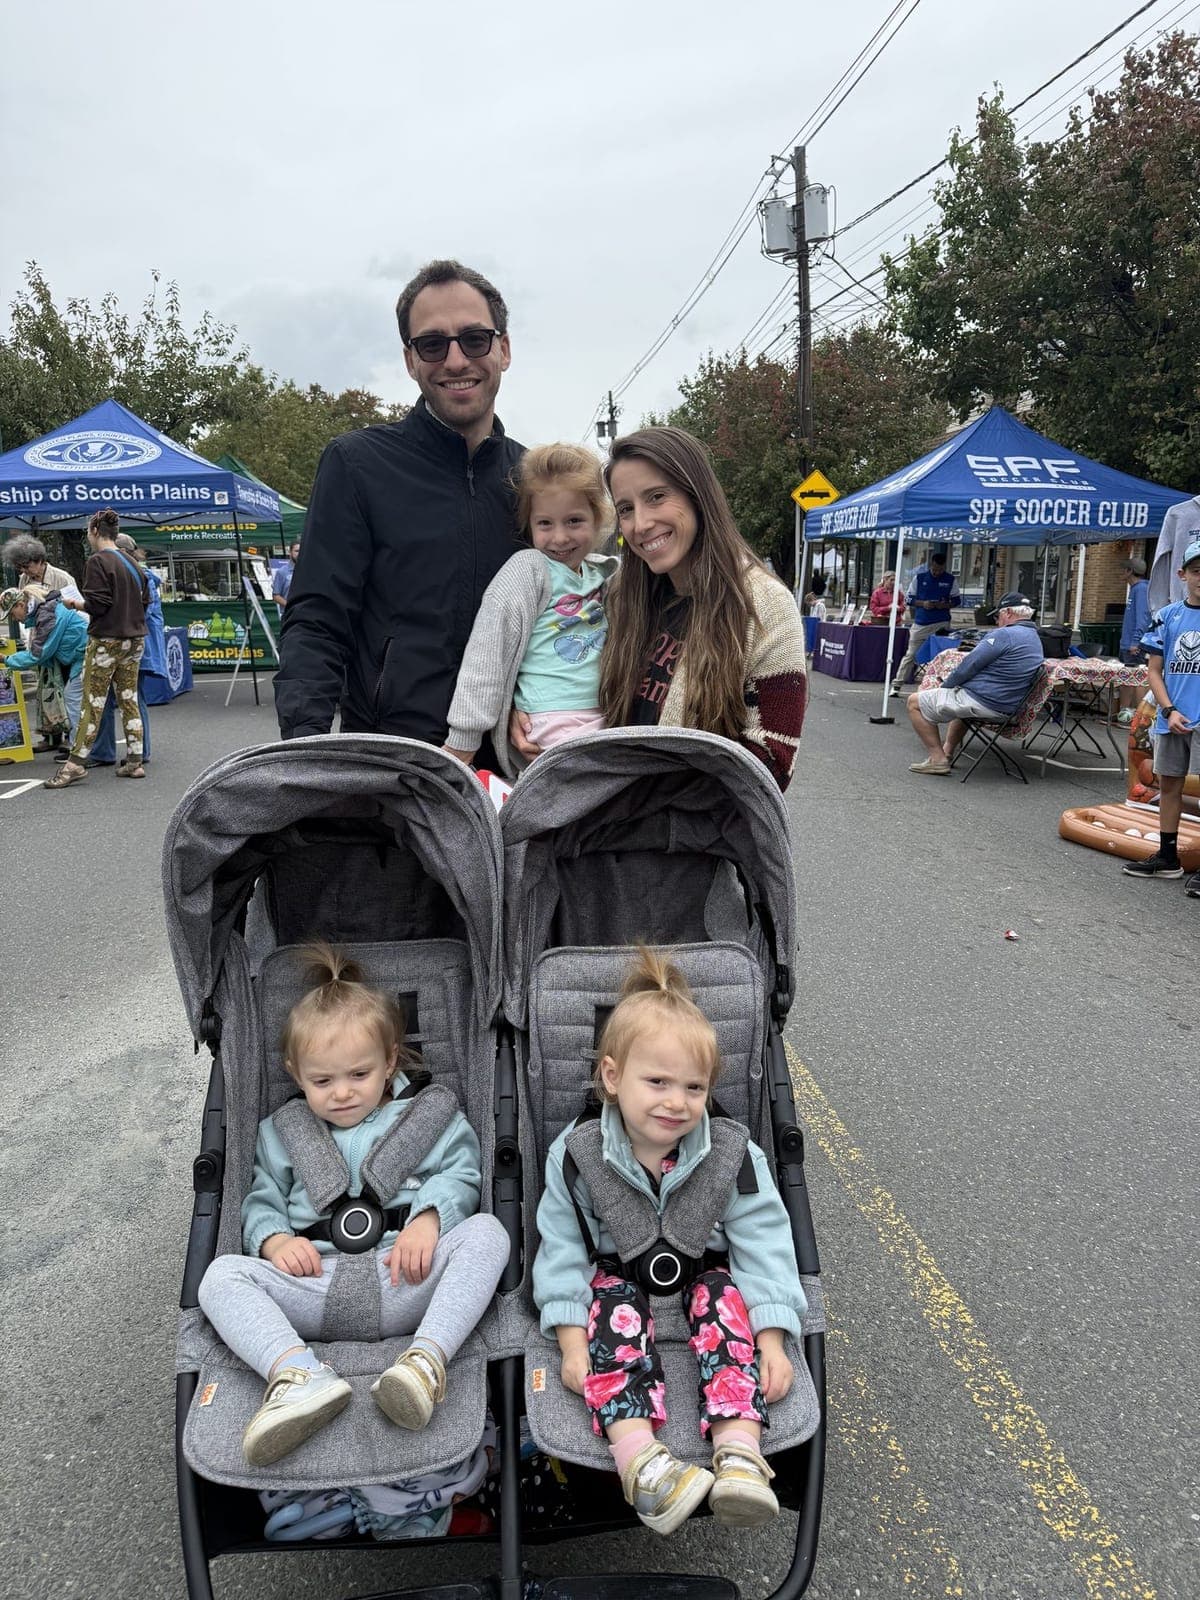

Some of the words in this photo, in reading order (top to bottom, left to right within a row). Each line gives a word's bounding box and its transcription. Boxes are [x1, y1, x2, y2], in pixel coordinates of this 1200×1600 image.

[966, 454, 1081, 478] SPF
[1049, 478, 1090, 486] CLUB
[0, 486, 43, 506] ship
[49, 484, 70, 501] of
[75, 483, 144, 501] Scotch
[150, 483, 211, 500] Plains
[820, 512, 834, 535] SPF
[833, 506, 859, 533] SOCCER
[858, 502, 880, 529] CLUB
[968, 498, 1007, 525] SPF
[1013, 498, 1091, 526] SOCCER
[1098, 501, 1149, 528] CLUB
[171, 532, 193, 541] Parks
[193, 532, 200, 540] &
[189, 648, 224, 659] cotch
